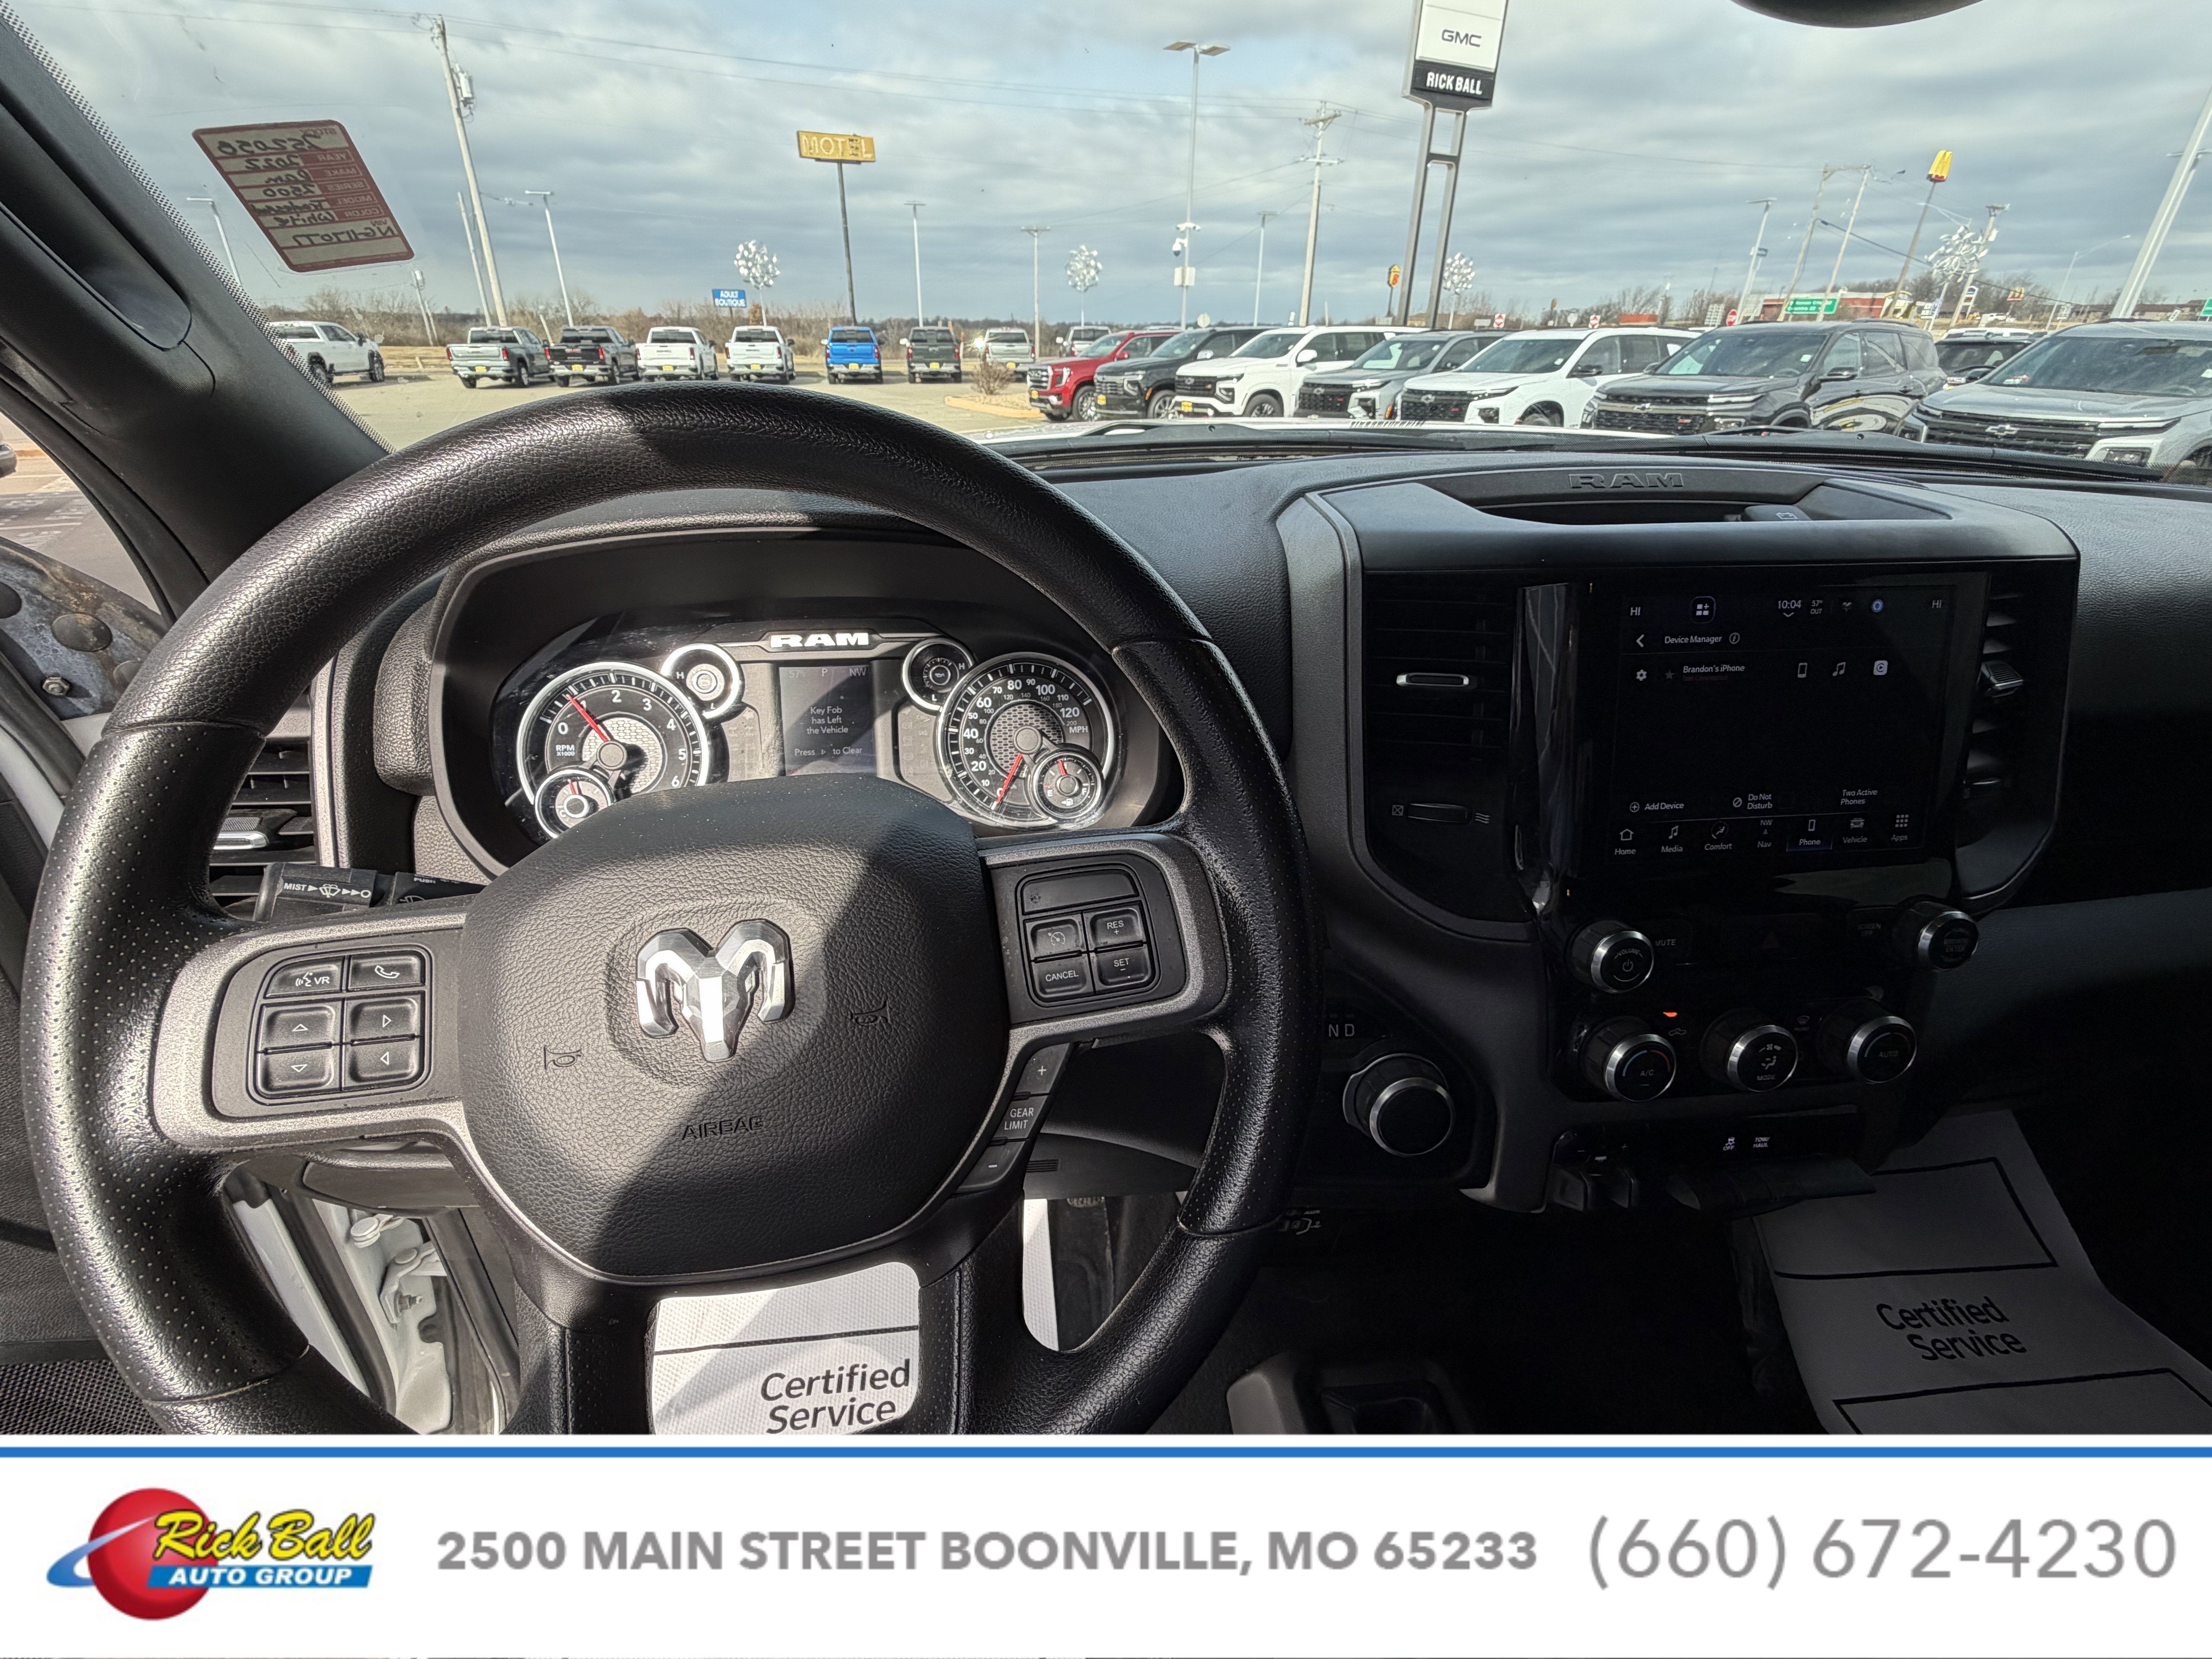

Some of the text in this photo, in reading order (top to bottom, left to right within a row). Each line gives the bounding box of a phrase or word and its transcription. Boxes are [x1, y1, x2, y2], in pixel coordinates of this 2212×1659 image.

[1441, 29, 1482, 47] GMC
[1426, 72, 1483, 95] RICK BALL
[802, 135, 872, 158] MOTEL
[714, 298, 746, 307] BOUTIQUE
[1568, 472, 1684, 489] RAM
[1778, 599, 1802, 609] 10:04
[1931, 599, 1942, 609] HI
[1630, 606, 1641, 617] HI
[770, 632, 869, 648] RAM
[1664, 635, 1723, 645] Device Manager
[821, 668, 828, 677] P
[849, 668, 867, 677] NW
[1682, 664, 1746, 674] Brandon's iPhone
[676, 671, 684, 679] H
[1007, 679, 1022, 690] 80
[992, 686, 1003, 695] 70
[1036, 684, 1056, 696] 100
[611, 689, 622, 703] 2
[642, 698, 653, 711] 3
[976, 697, 992, 709] 60
[810, 706, 843, 716] Key Fob
[1060, 707, 1080, 718] 120
[666, 718, 677, 731] 4
[827, 716, 842, 724] Left
[558, 722, 568, 735] 0
[820, 726, 849, 734] Vehicle
[963, 728, 979, 739] 40
[1069, 725, 1089, 734] MPH
[678, 748, 687, 761] 5
[971, 761, 987, 772] 20
[671, 775, 680, 787] 6
[1747, 793, 1759, 801] Do
[1841, 788, 1879, 797] Two Active
[1644, 801, 1685, 811] Add Device
[1747, 801, 1773, 810] Disturb
[1840, 797, 1866, 805] Phones
[1798, 838, 1821, 847] Phone
[1843, 835, 1869, 844] Vehicle
[1890, 834, 1909, 843] Apps
[1704, 842, 1733, 851] Comfort
[1757, 840, 1772, 848] Nav
[1660, 845, 1684, 854] Media
[283, 883, 307, 892] MIST
[1106, 920, 1125, 930] RES
[1655, 938, 1677, 947] MUTE
[1113, 957, 1130, 968] SET
[314, 976, 330, 985] VR
[1045, 969, 1079, 982] CANCEL
[1328, 1023, 1355, 1037] N D
[1640, 1069, 1654, 1077] A/C
[1010, 1107, 1034, 1118] GEAR
[682, 1116, 764, 1141] AIRBAG
[1004, 1120, 1029, 1130] LIMIT
[1876, 1295, 2010, 1330] Certified
[1906, 1329, 2028, 1361] Service
[760, 1358, 910, 1401] Certified
[766, 1396, 896, 1434] Service
